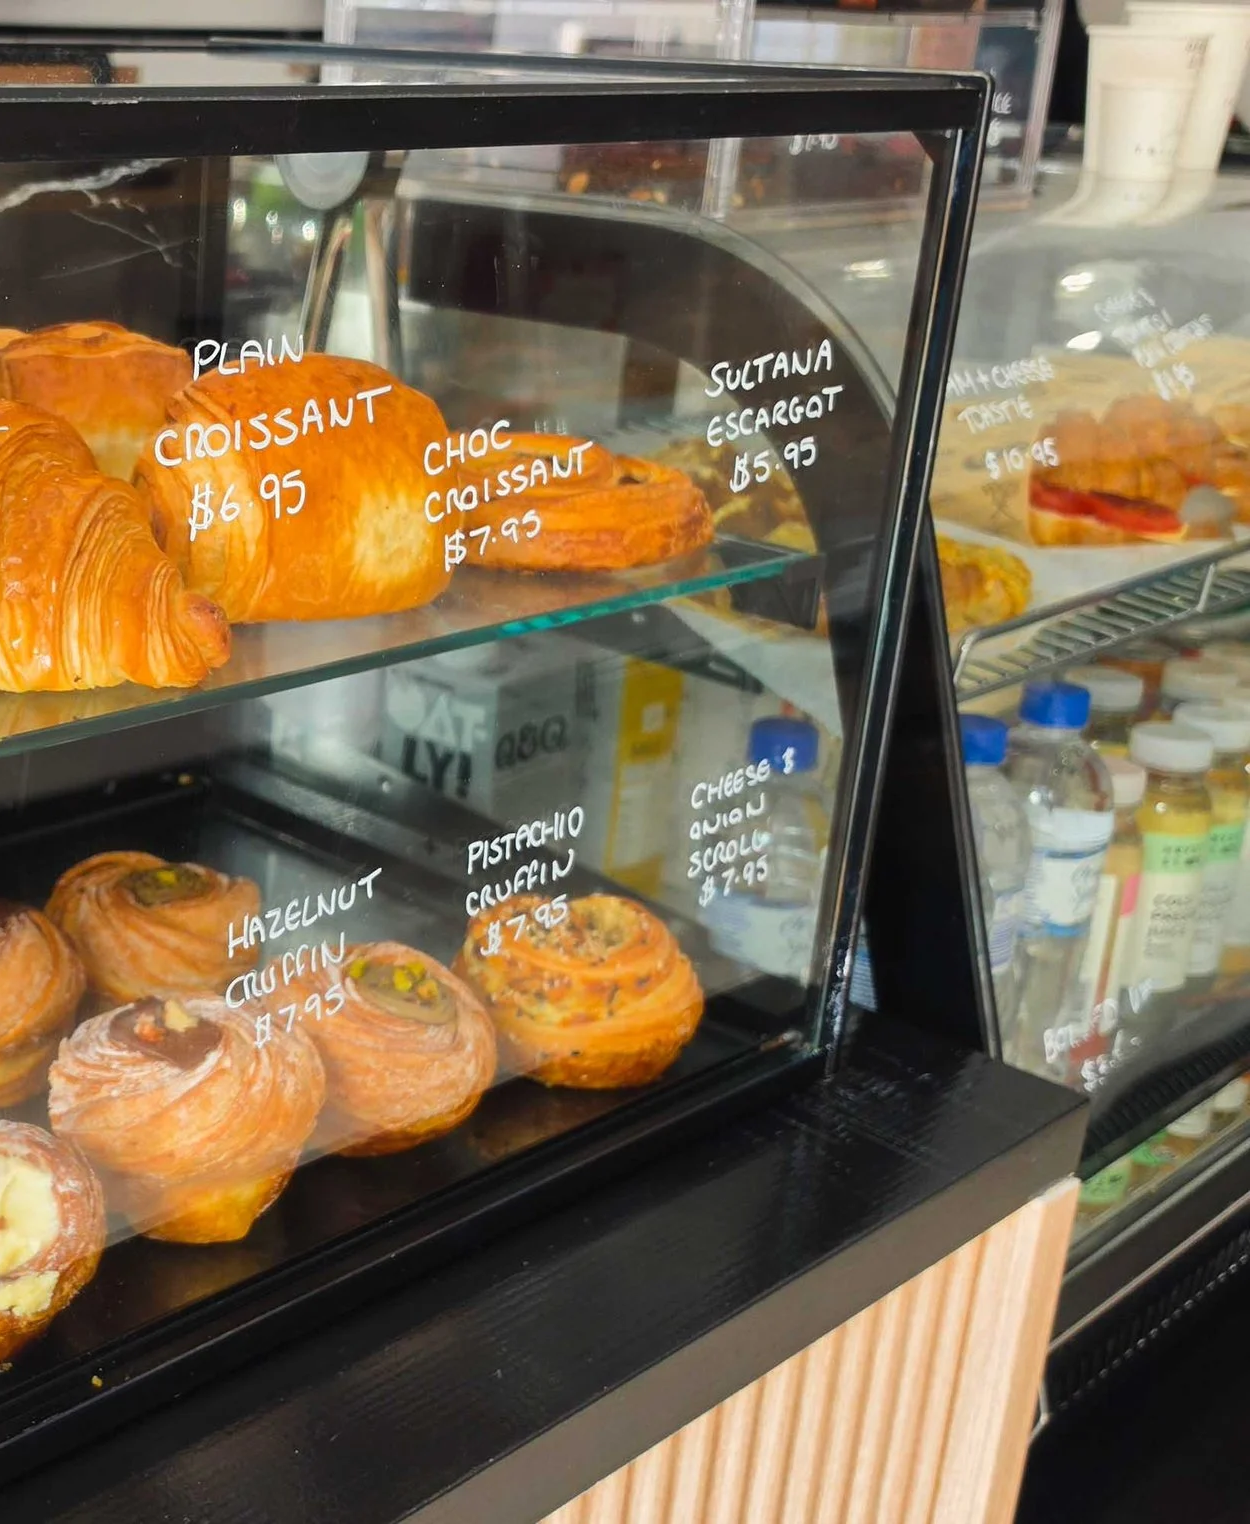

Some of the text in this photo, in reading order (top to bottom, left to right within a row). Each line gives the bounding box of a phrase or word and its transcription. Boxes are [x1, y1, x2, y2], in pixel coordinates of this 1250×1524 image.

[192, 334, 304, 380] PLAIN
[704, 338, 832, 397] SULTANA
[154, 385, 393, 468] CROISSANT
[422, 420, 512, 477] CHOC
[706, 384, 843, 447] ESCARGOT
[423, 441, 594, 525] CROISSANT
[729, 436, 817, 493] $5.95
[189, 469, 307, 543] $6.95
[444, 509, 543, 572] $7.95
[690, 757, 772, 811] CHEESE
[467, 805, 585, 876] PISTACHIO
[227, 867, 384, 960] HAZELNUT
[464, 848, 576, 918] CRUFFIN
[698, 854, 771, 908] $7.95
[480, 893, 570, 960] $7.95
[225, 932, 347, 1011] CRUFFIN
[254, 984, 347, 1050] $7.95
